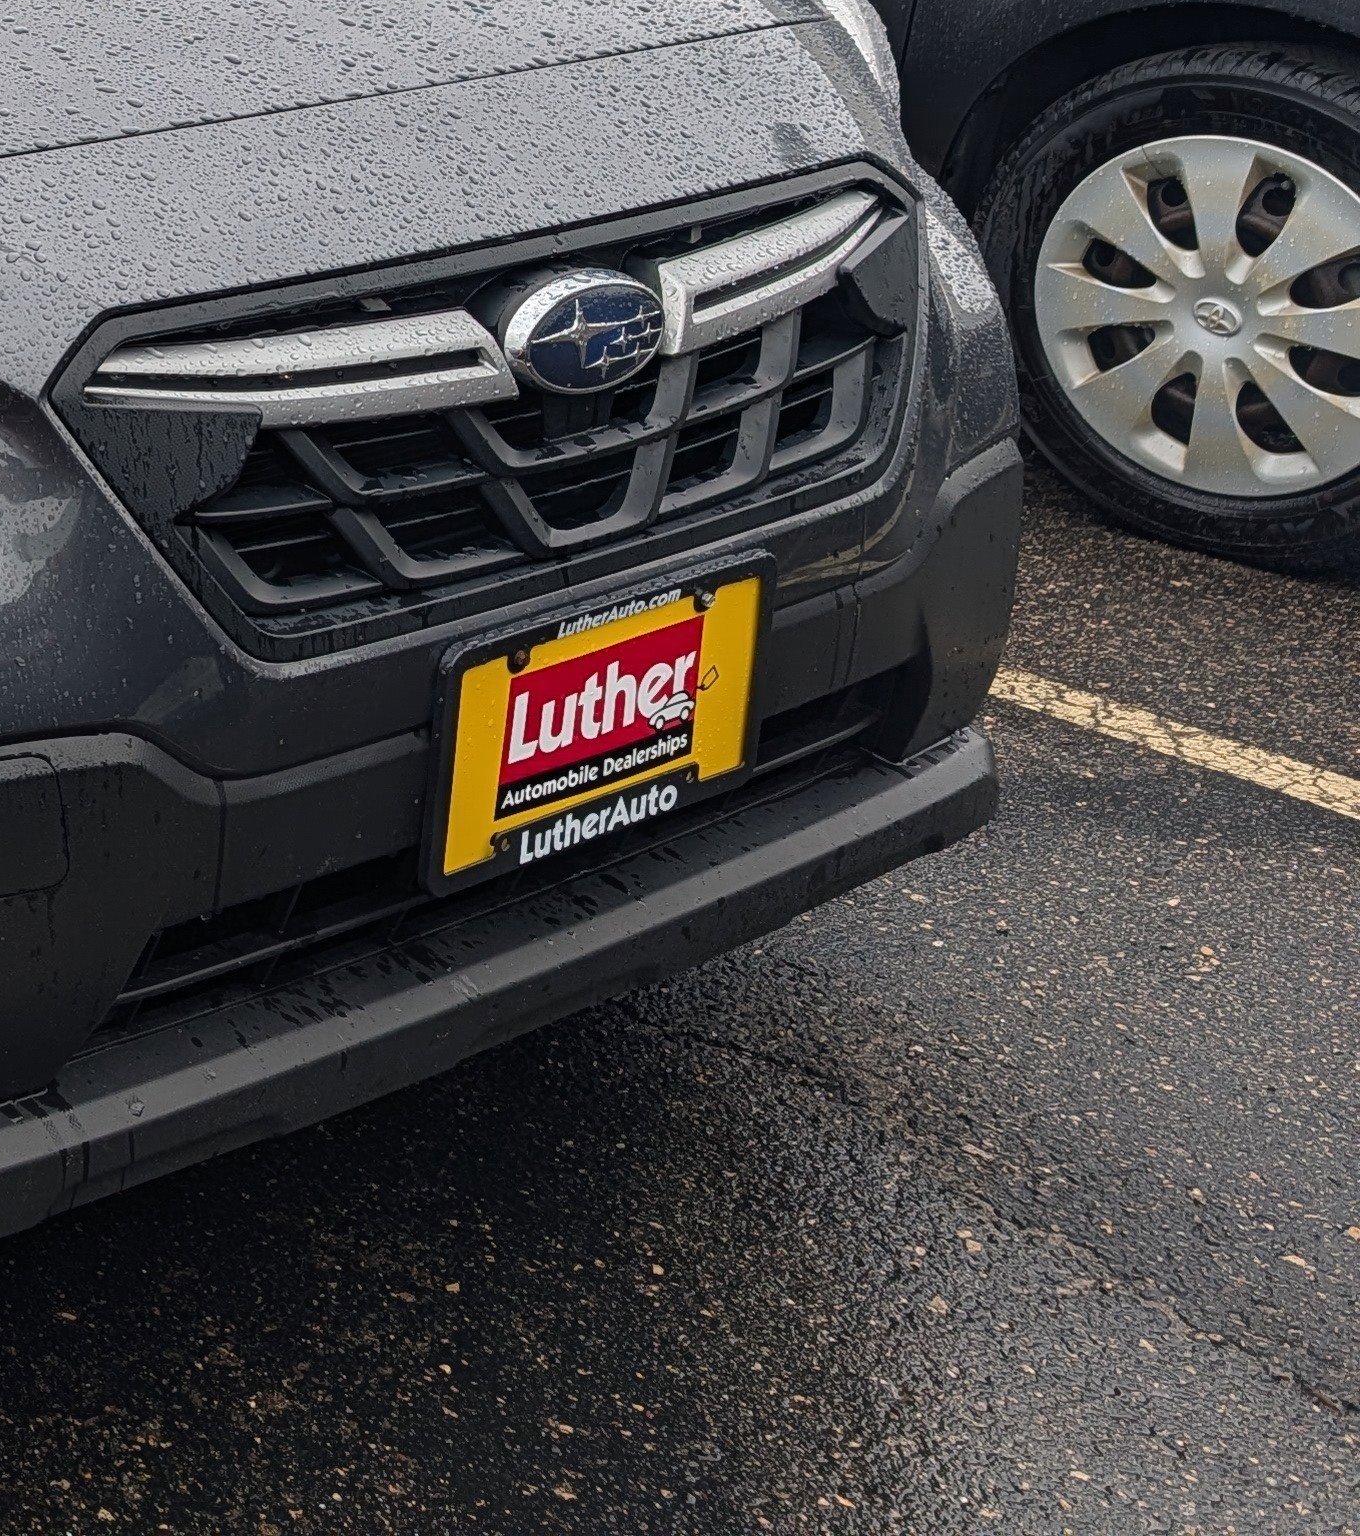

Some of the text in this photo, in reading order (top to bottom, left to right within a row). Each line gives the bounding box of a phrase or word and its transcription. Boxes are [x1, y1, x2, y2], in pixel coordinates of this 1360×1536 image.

[557, 588, 682, 640] LutherAuto.com
[507, 650, 697, 765] Luther
[501, 732, 689, 810] Automobile Dealerships
[519, 784, 678, 865] LutherAuto
